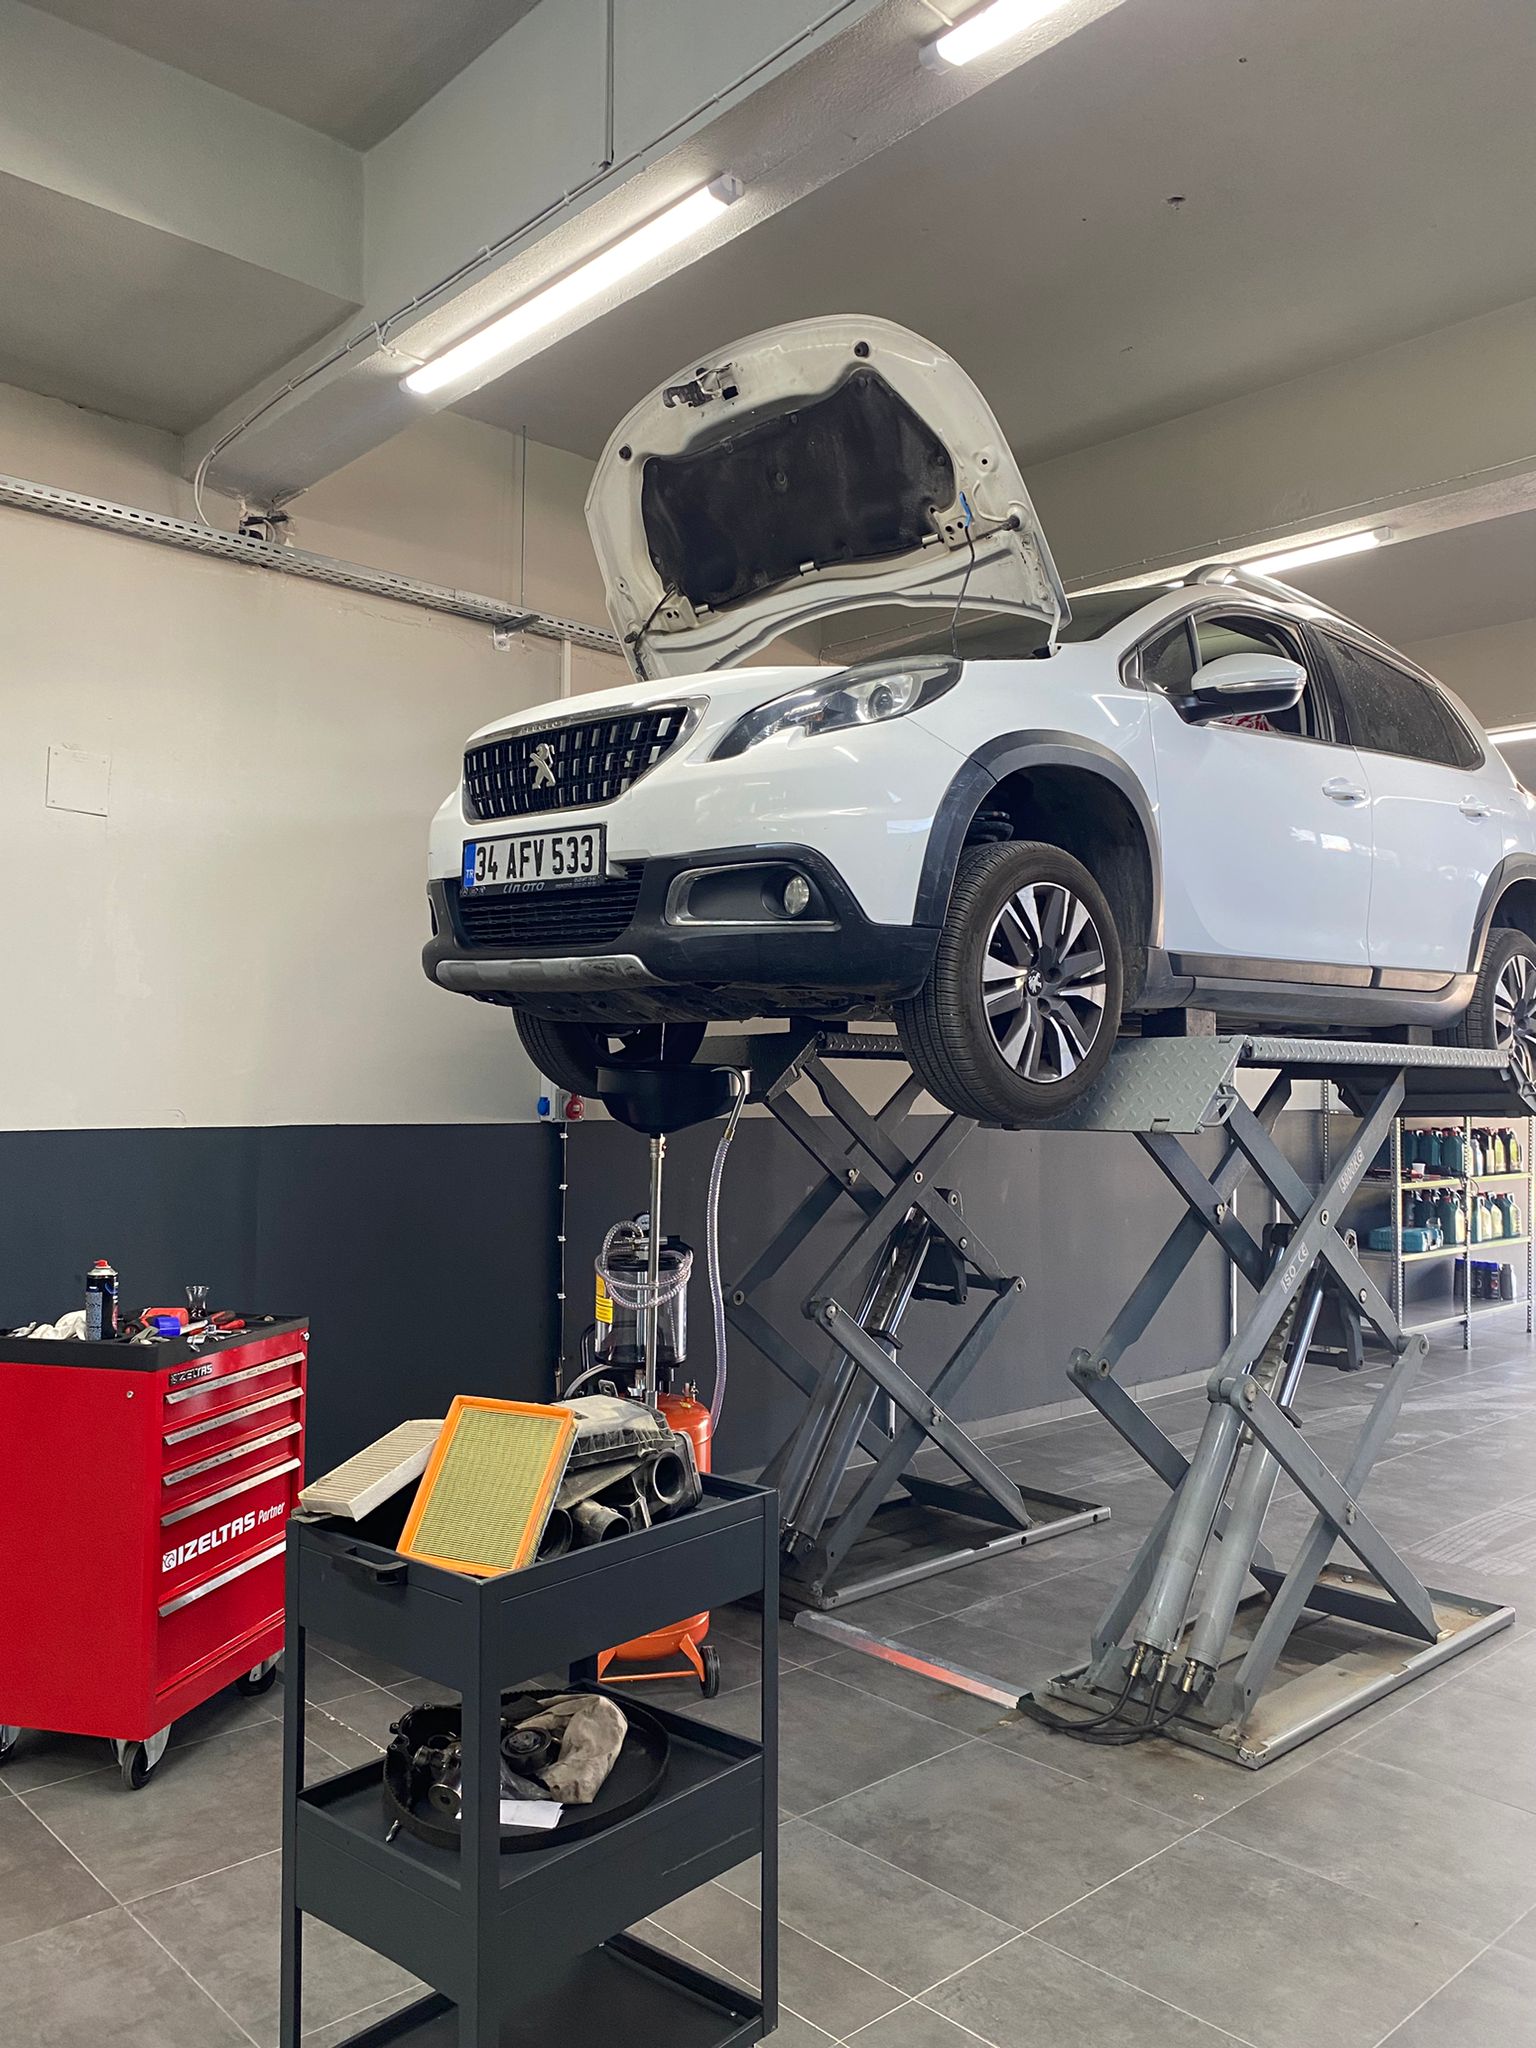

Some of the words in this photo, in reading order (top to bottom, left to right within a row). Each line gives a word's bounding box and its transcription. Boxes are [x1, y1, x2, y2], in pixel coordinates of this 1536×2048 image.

[466, 869, 474, 879] TR
[475, 845, 498, 881] 34
[506, 839, 545, 879] AFV
[551, 835, 593, 875] 533
[177, 1511, 256, 1566] IZELTAS
[257, 1502, 286, 1525] Partner
